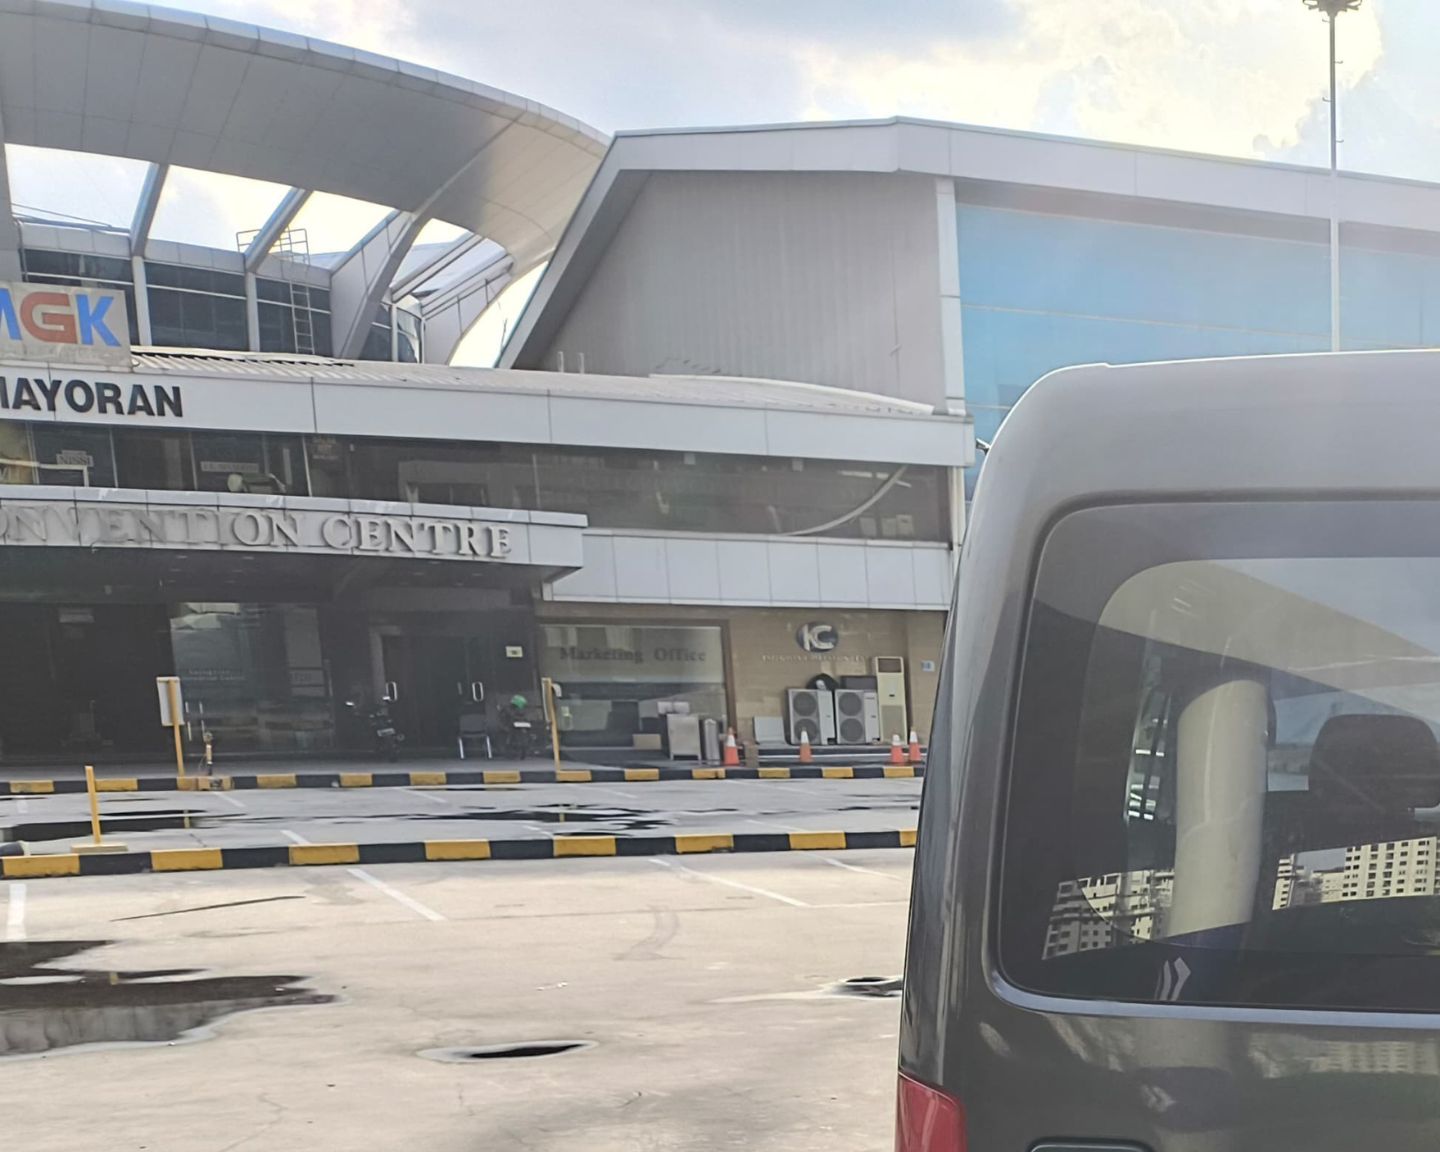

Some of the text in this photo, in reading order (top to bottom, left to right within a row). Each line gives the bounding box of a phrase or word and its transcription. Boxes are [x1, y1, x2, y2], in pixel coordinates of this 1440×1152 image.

[321, 515, 512, 557] CENTRE
[559, 646, 707, 664] Marketing Office
